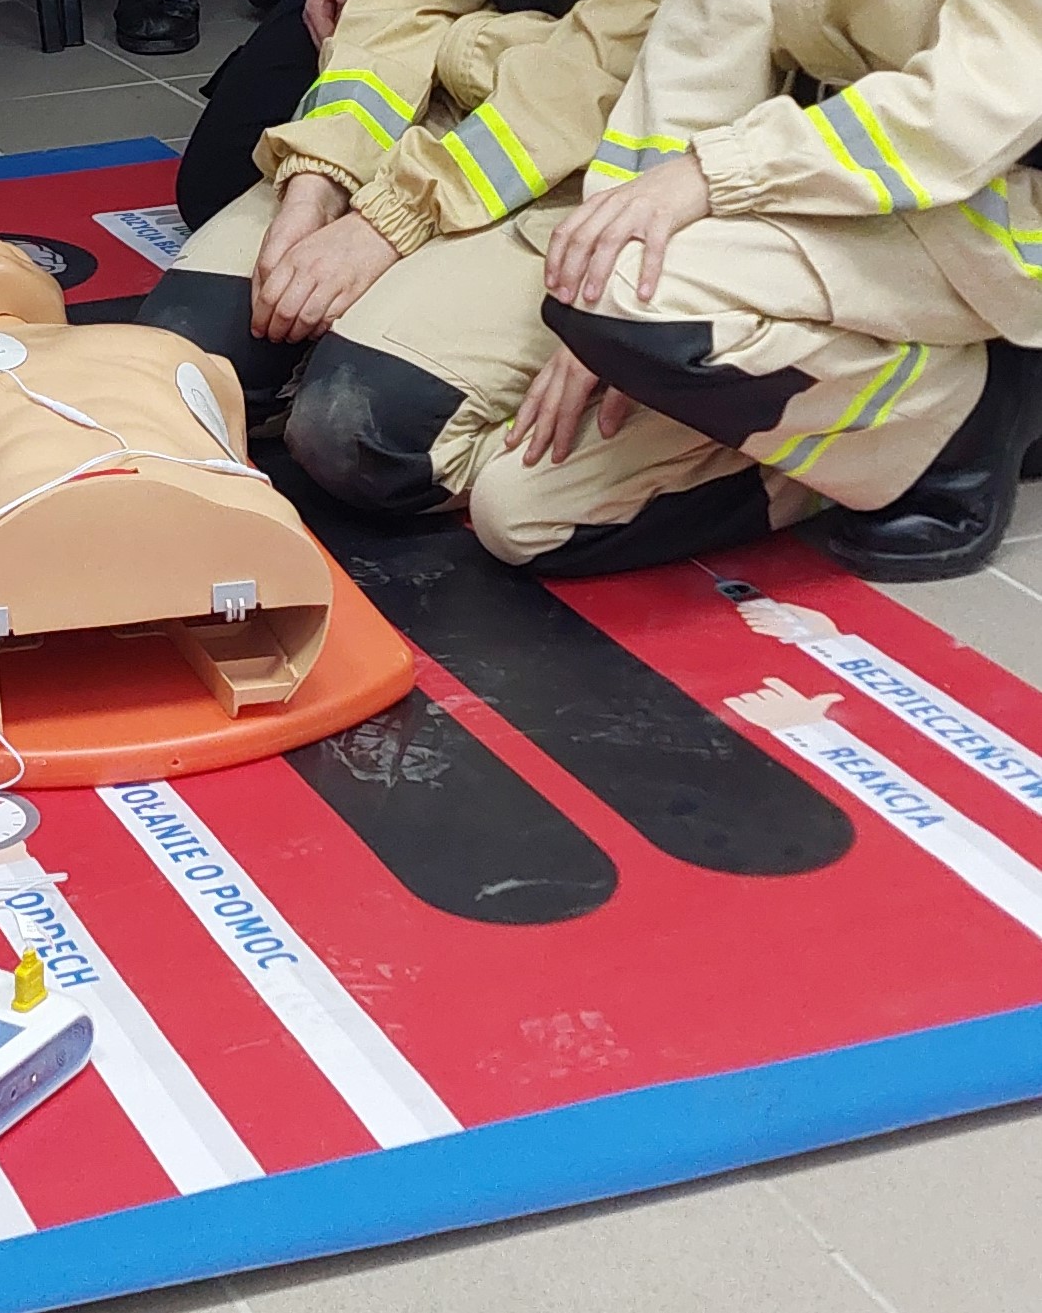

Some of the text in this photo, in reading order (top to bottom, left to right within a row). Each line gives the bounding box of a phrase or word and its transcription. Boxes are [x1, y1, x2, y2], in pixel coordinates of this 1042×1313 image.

[114, 213, 167, 242] POZYCJA
[818, 746, 944, 829] REAKCJA
[113, 783, 299, 970] OŁANIE O POMOC
